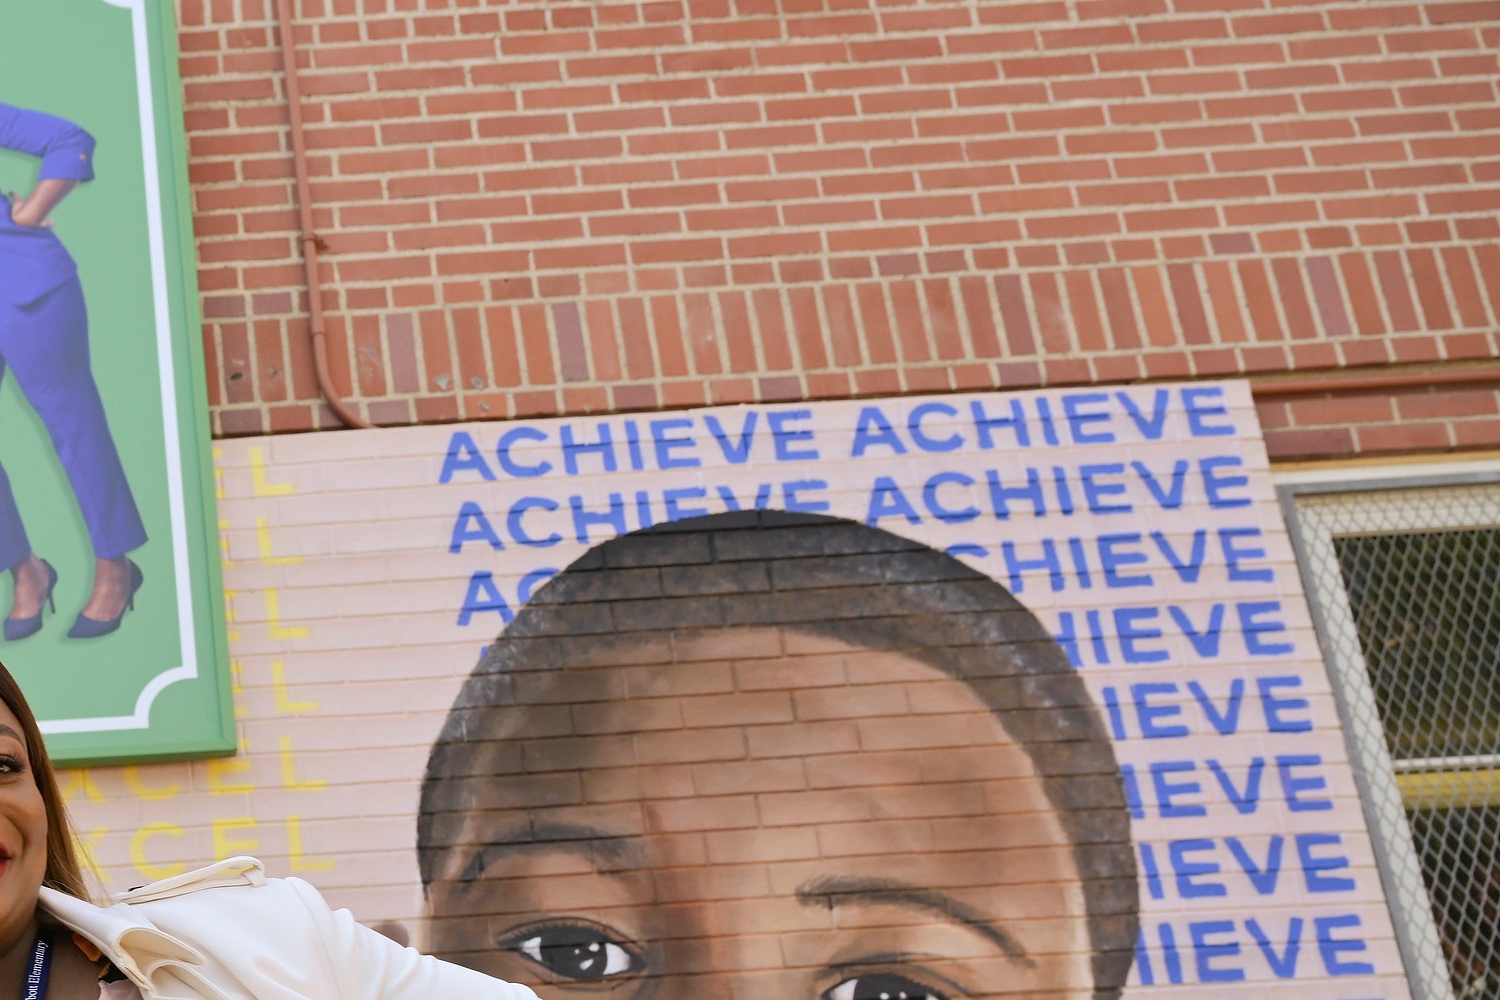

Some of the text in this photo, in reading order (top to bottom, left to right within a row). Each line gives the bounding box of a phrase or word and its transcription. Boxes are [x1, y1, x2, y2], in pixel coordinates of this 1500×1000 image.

[438, 387, 1236, 484] ACHIEVE ACHIEVE
[866, 456, 1252, 528] ACHIEVE
[1102, 675, 1314, 741] IEVE
[1139, 832, 1357, 899] IEVE
[28, 940, 49, 984] Elementary
